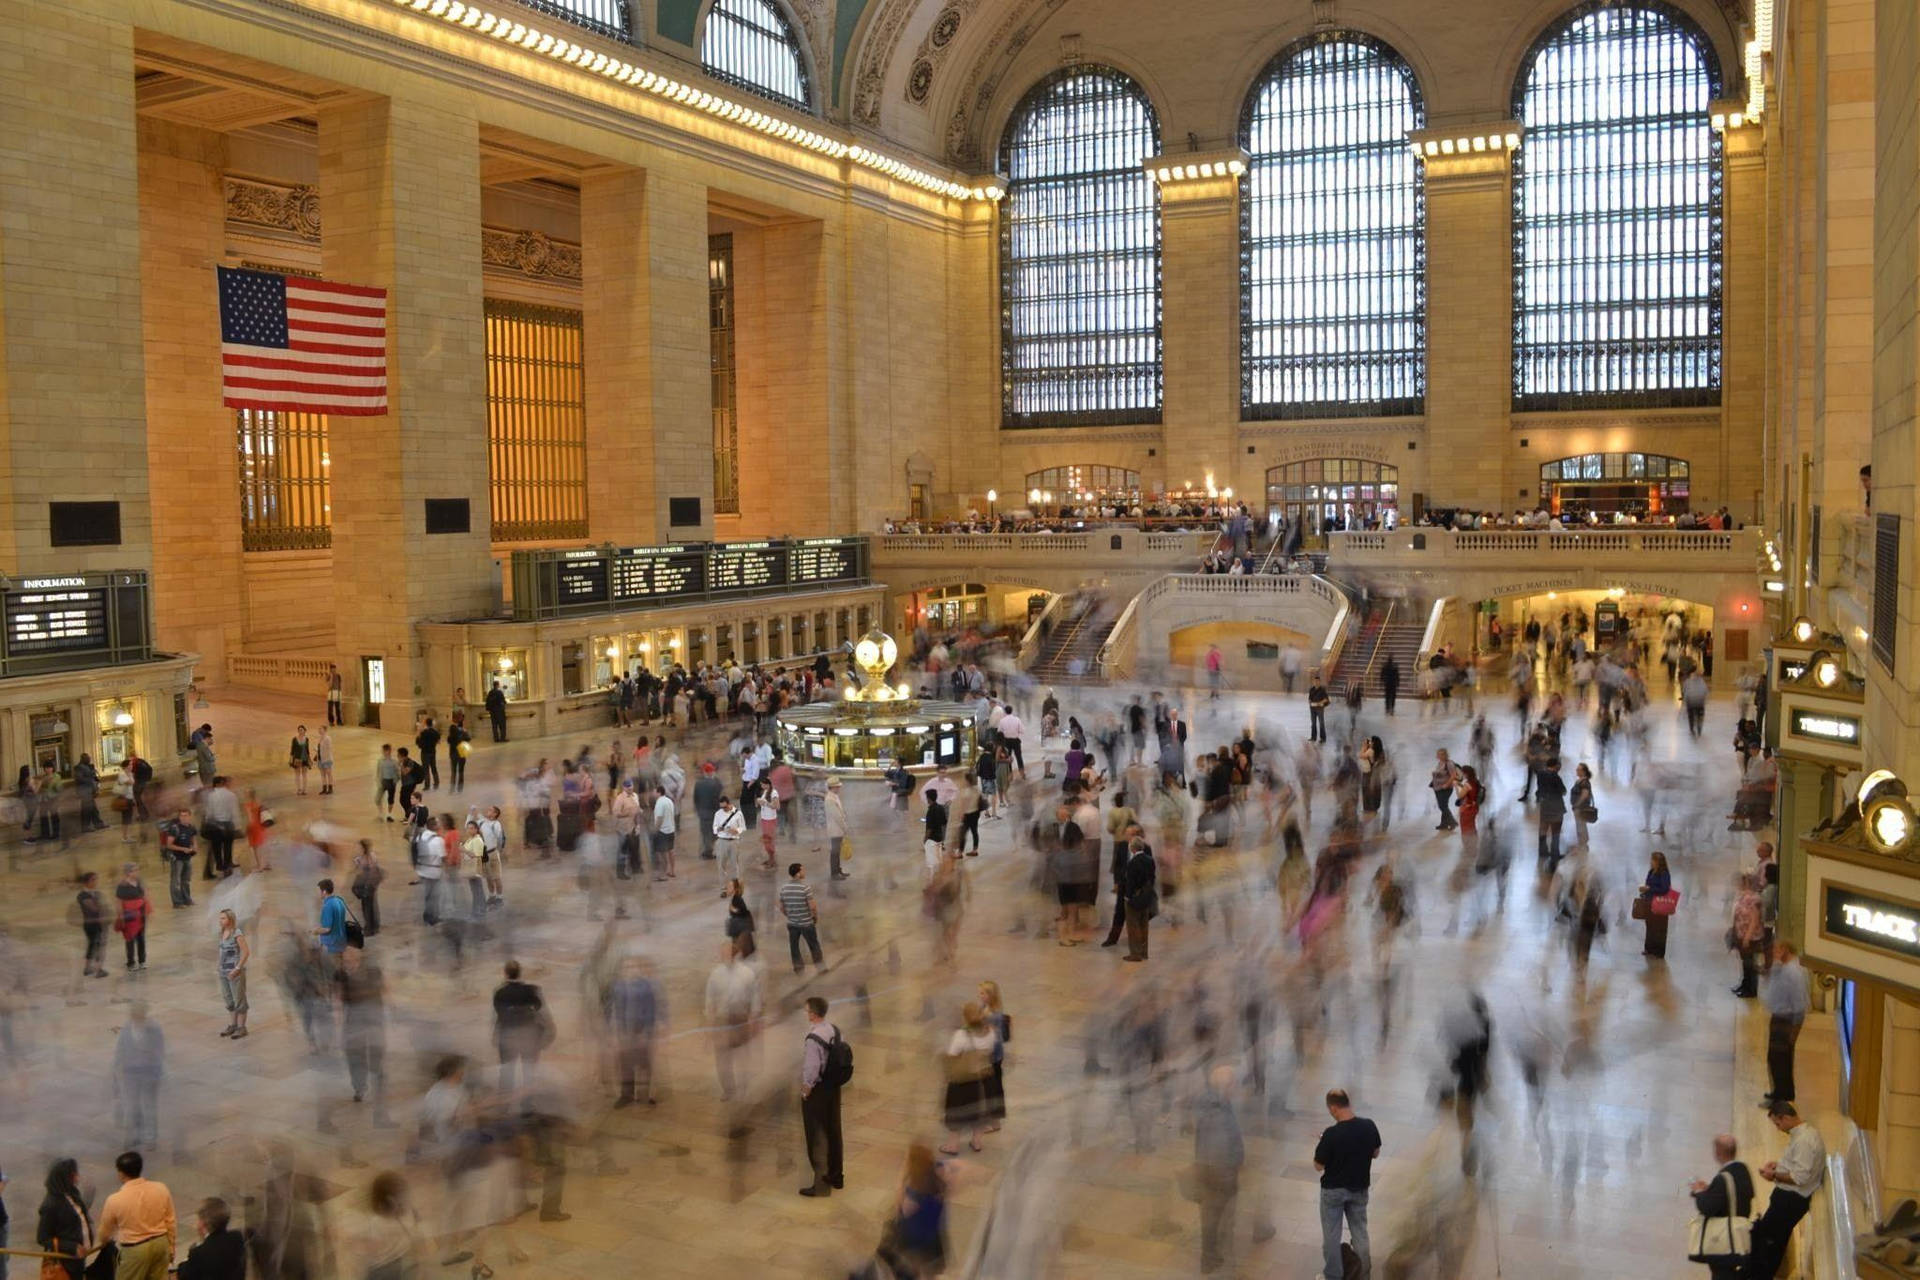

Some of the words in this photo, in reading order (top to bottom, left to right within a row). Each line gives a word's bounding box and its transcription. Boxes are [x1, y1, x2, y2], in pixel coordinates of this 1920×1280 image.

[24, 578, 85, 589] INFORMATION
[1493, 583, 1521, 595] TICKET
[1526, 578, 1573, 590] MACHINES
[1842, 903, 1918, 943] TRACK
